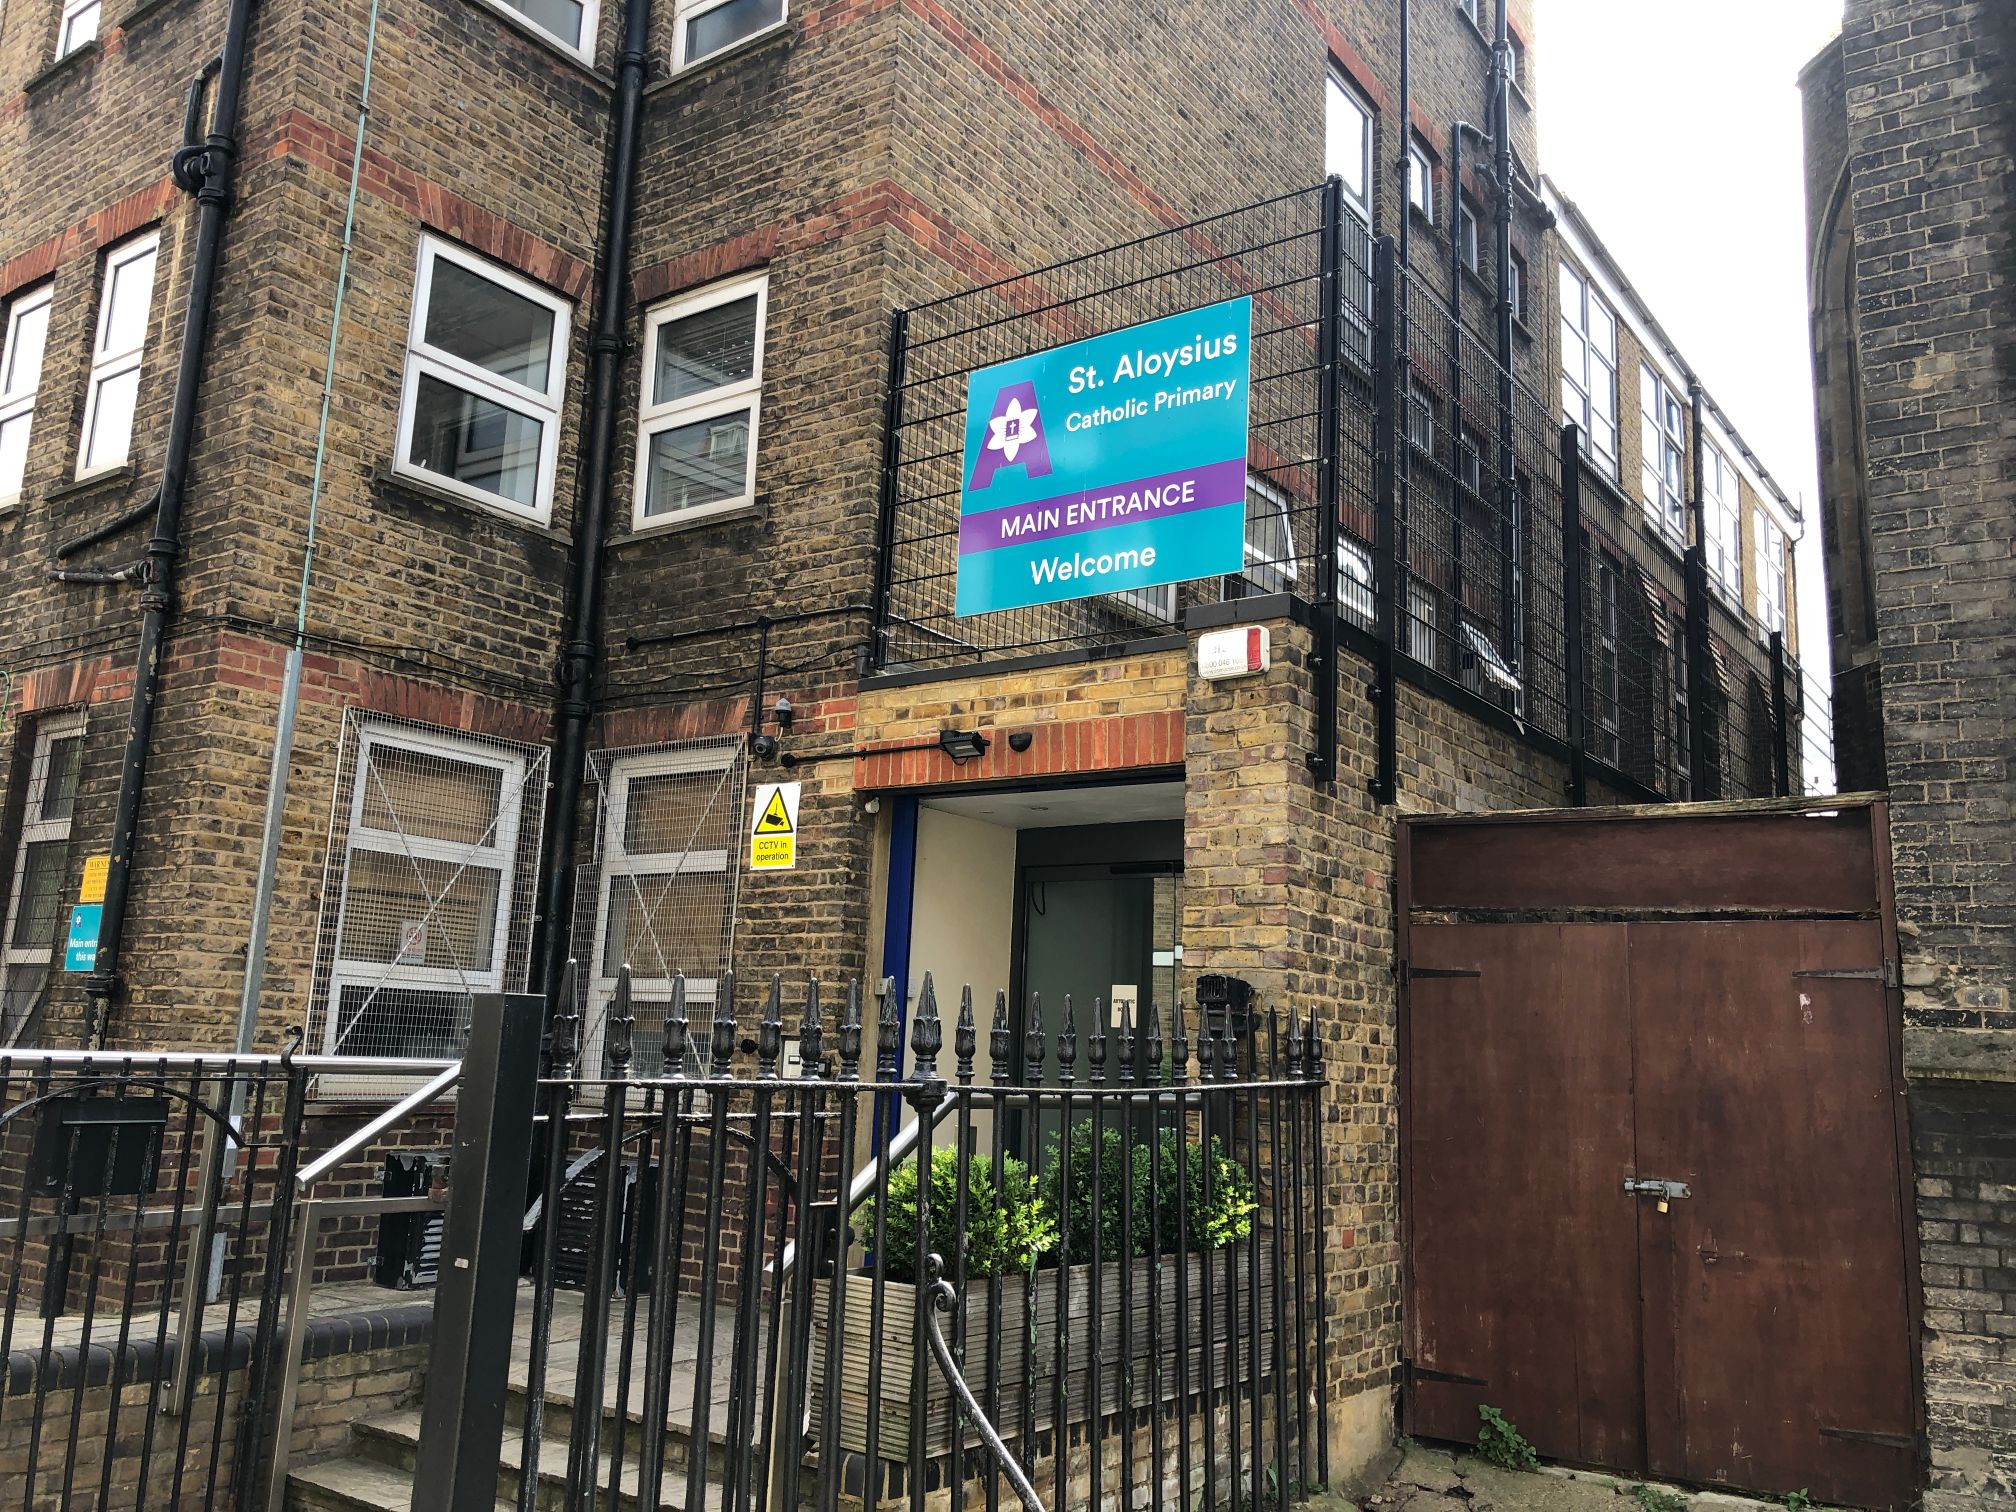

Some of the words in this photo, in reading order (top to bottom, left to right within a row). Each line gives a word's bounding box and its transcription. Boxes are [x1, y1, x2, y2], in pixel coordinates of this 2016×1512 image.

[1068, 365, 1105, 394] St.
[1112, 334, 1237, 384] Aloysius
[1066, 397, 1149, 432] Catholic
[1154, 379, 1237, 412] Primary
[1000, 508, 1060, 538] MAIN
[1066, 480, 1196, 526] ENTRANCE
[1030, 546, 1157, 585] Welcome
[756, 853, 789, 861] operation
[759, 841, 779, 849] CCTV
[70, 938, 84, 948] Main
[75, 951, 87, 961] this
[87, 953, 96, 961] wa
